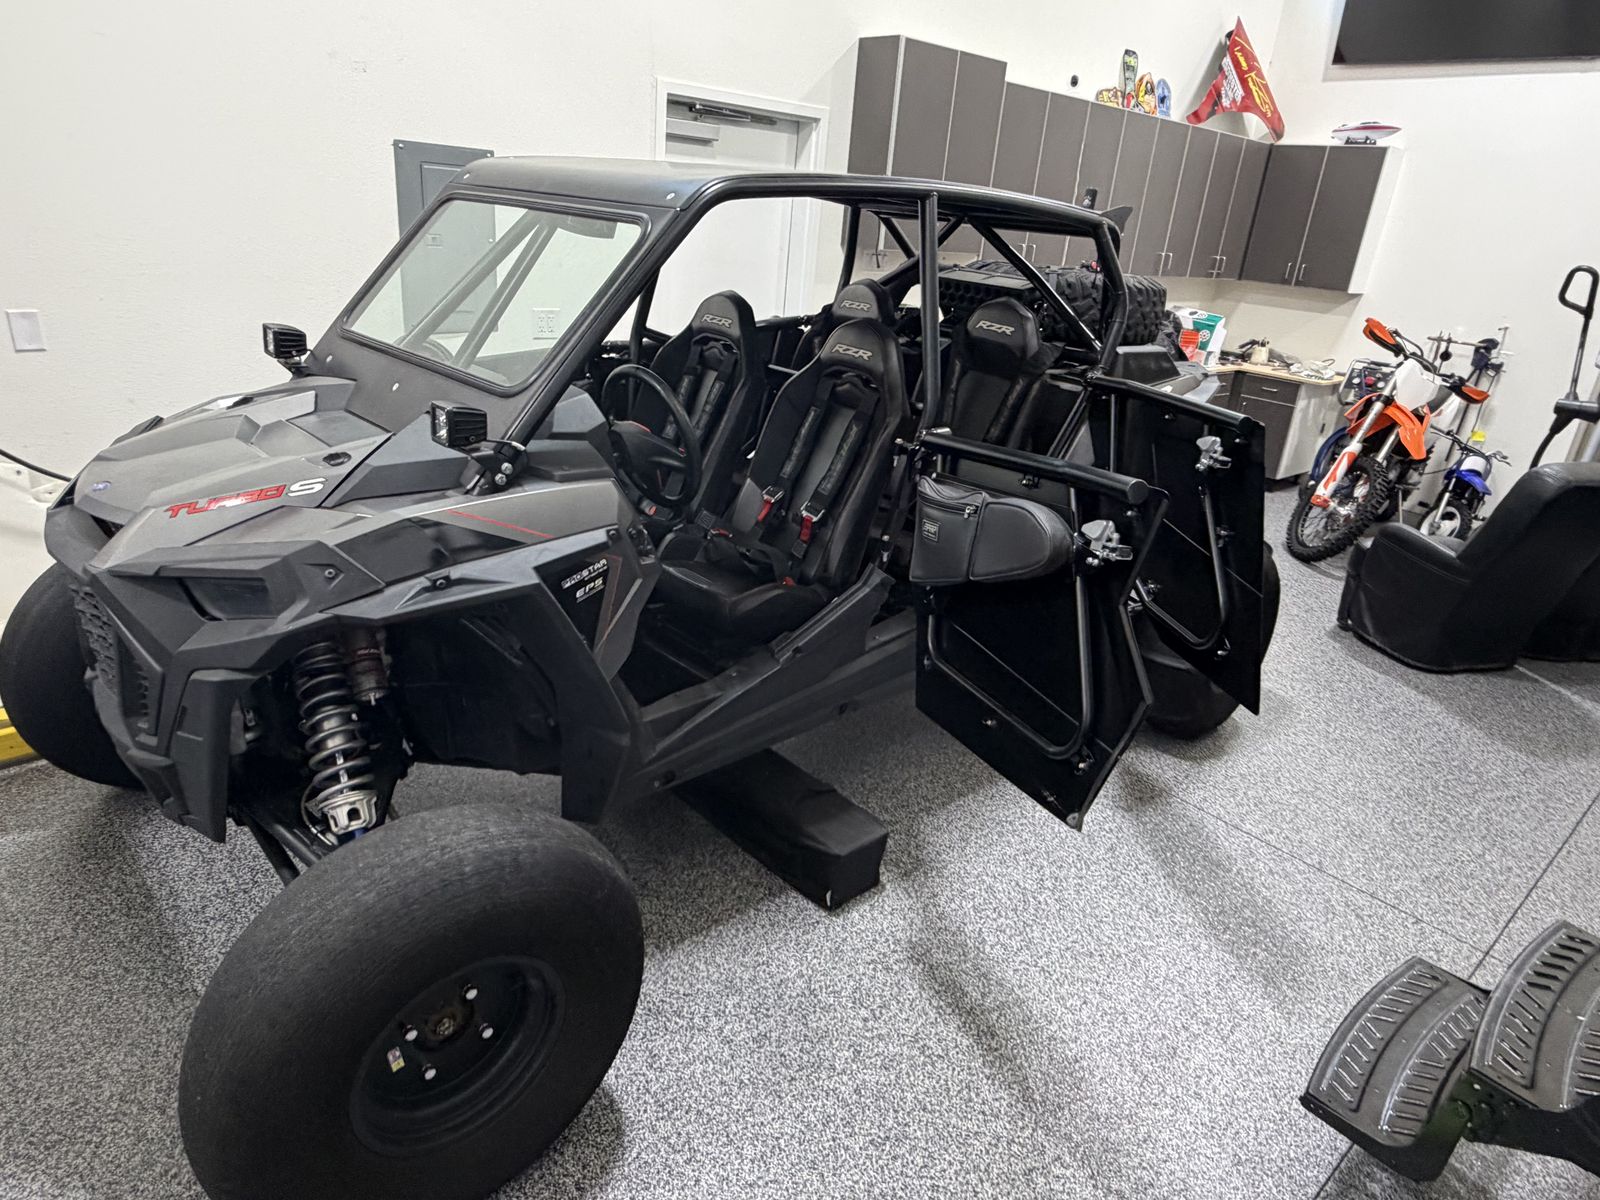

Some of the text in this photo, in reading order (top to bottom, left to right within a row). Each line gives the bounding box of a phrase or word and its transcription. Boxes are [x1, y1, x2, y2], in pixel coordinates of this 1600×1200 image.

[840, 300, 873, 311] RZR
[701, 314, 733, 328] RZR
[975, 320, 1015, 336] RZR
[831, 343, 873, 361] RZR
[164, 477, 327, 519] TURBO S
[575, 577, 604, 599] EPS
